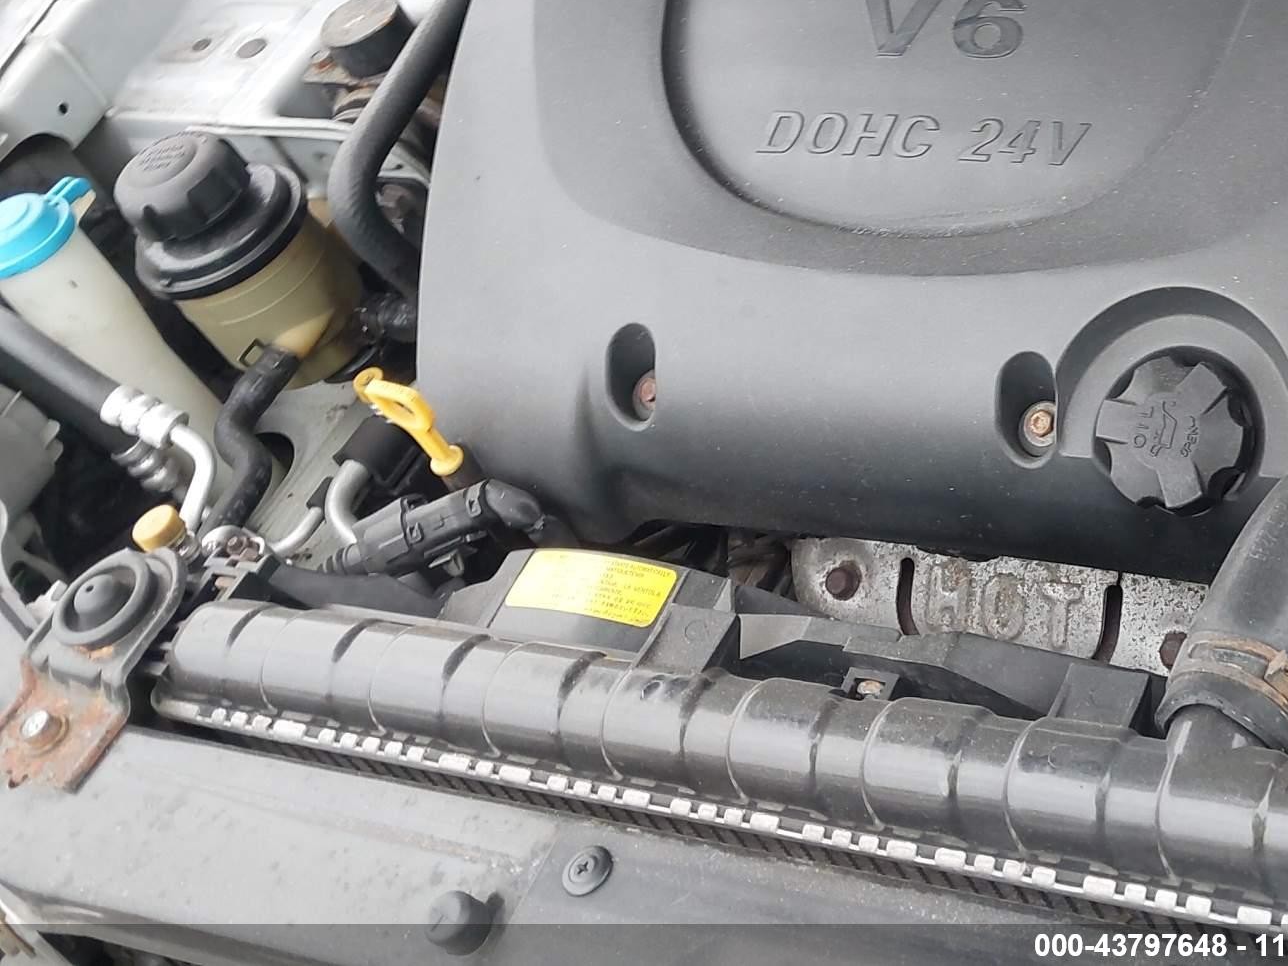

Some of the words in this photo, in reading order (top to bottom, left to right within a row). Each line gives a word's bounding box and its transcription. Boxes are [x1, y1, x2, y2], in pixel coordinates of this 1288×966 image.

[755, 109, 940, 159] DOHC
[958, 117, 1092, 166] 24V
[1134, 406, 1154, 449] OIL
[924, 556, 1084, 651] HOT
